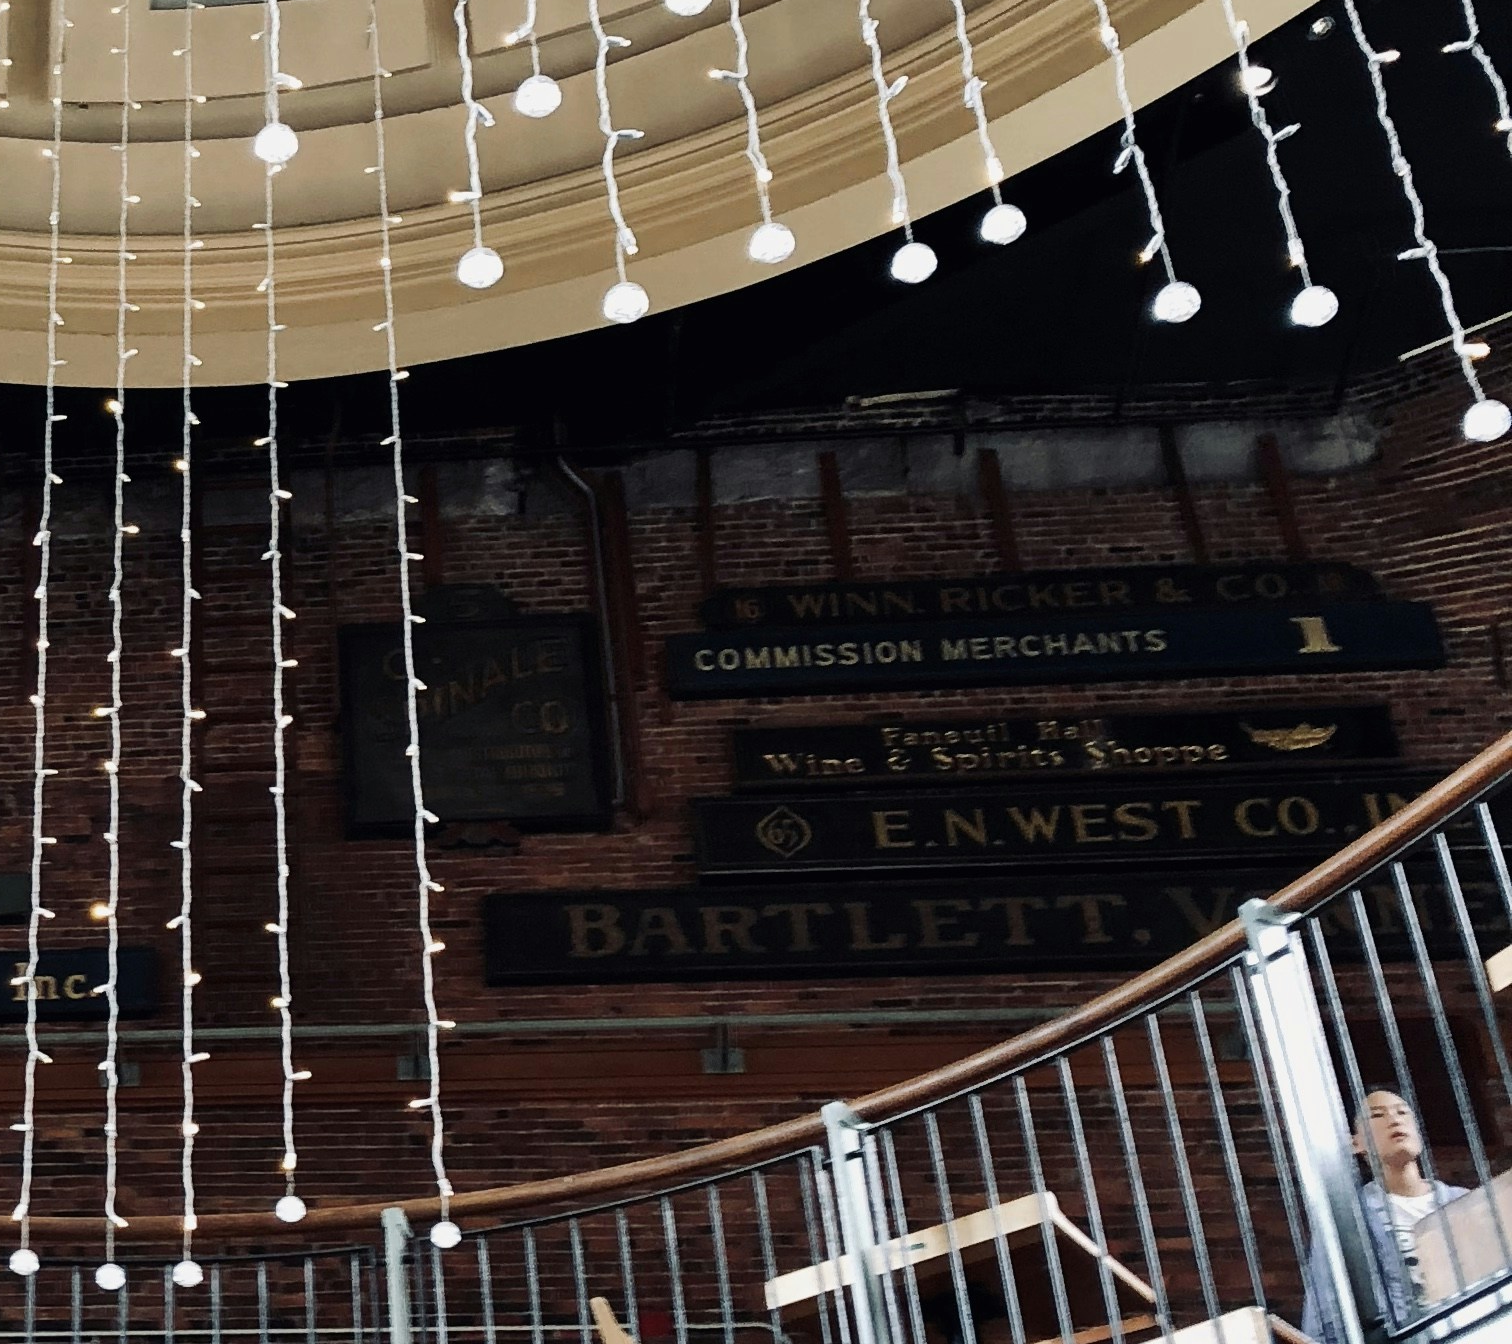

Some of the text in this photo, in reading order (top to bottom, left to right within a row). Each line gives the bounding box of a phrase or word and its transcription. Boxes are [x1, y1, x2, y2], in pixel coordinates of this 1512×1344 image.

[938, 579, 1136, 614] RICKER
[1152, 576, 1193, 603] &
[693, 638, 924, 672] COMMISSION
[939, 629, 1170, 662] MERCHANTS
[761, 752, 866, 777] Wine
[928, 743, 1065, 774] Spirits
[1084, 740, 1229, 771] Shoppe
